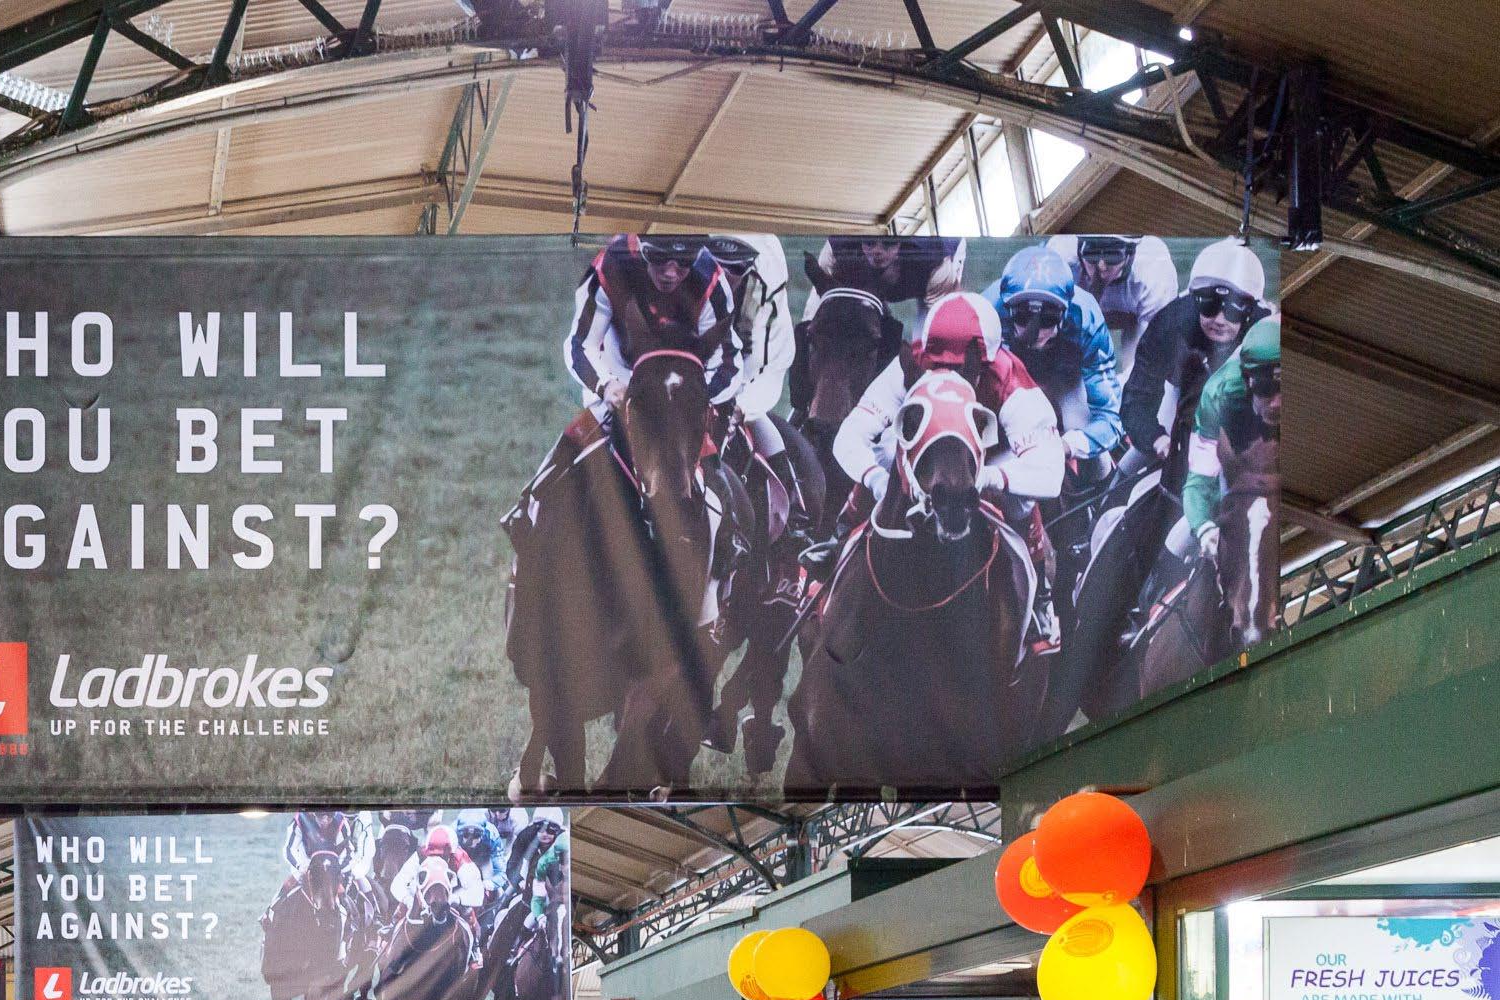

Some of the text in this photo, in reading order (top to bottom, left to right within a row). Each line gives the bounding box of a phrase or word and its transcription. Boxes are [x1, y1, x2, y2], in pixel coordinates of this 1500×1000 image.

[179, 312, 386, 377] WILL
[176, 408, 348, 474] BET
[50, 654, 334, 708] Ladbrokes
[51, 719, 329, 736] UP FOR THE CHALLENGE
[36, 836, 214, 864] WHO WILL
[36, 874, 198, 903] YOU BET
[36, 912, 219, 941] AGAINST?
[1316, 954, 1347, 967] OUR
[79, 970, 194, 996] Ladbrokes
[1290, 969, 1461, 988] FRESH JUICES
